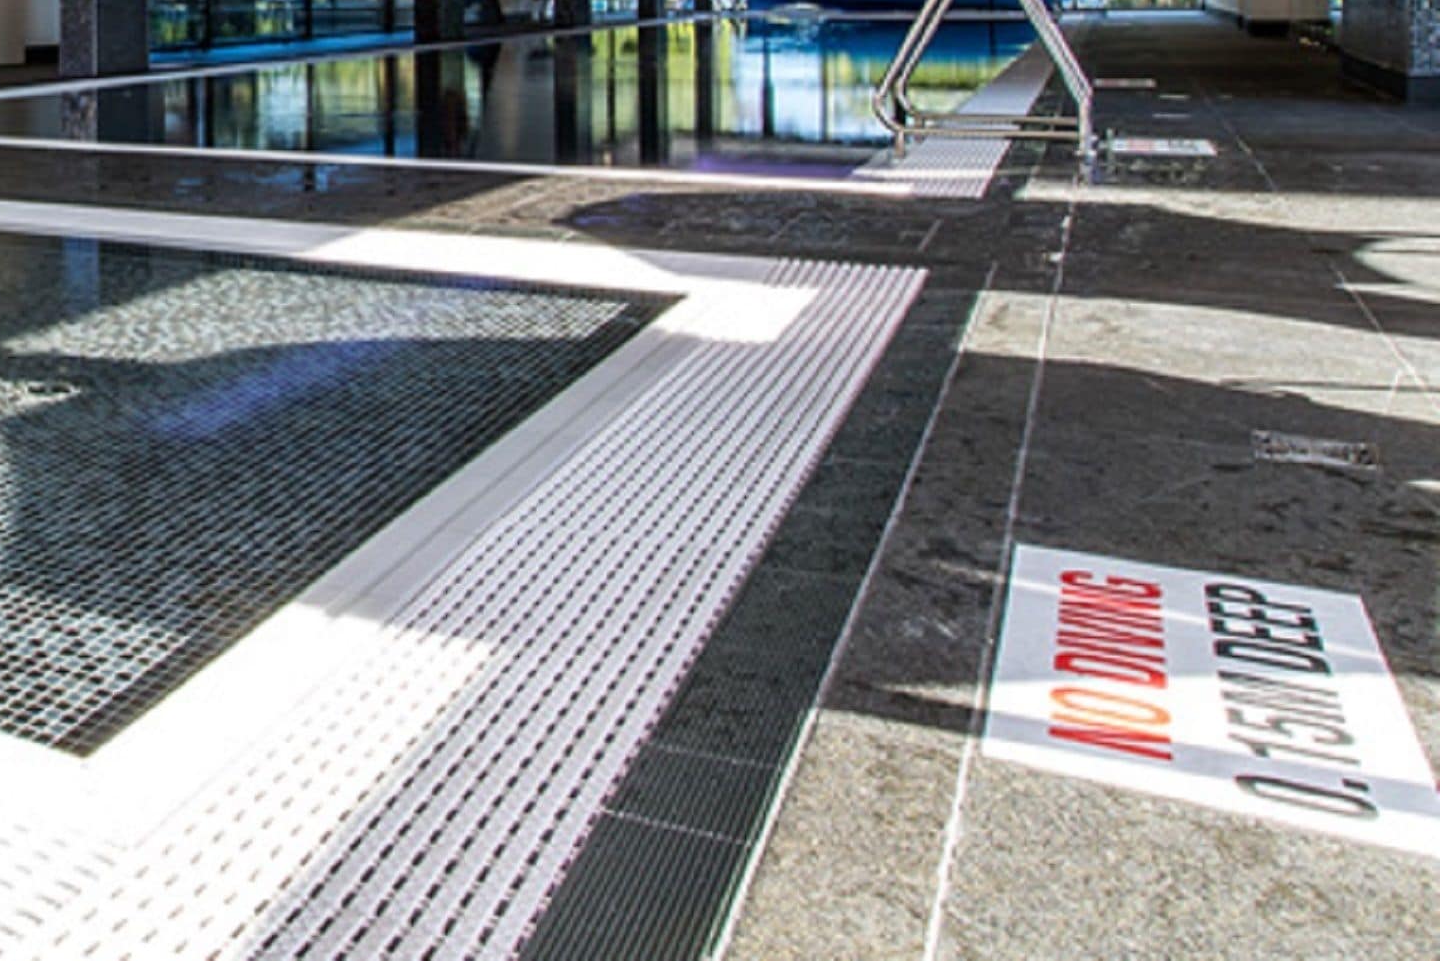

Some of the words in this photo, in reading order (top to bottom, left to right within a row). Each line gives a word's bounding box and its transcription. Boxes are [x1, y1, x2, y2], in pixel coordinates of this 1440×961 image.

[1054, 571, 1166, 688] DIVING
[1205, 583, 1331, 674] DEEP
[1048, 688, 1172, 761] NO
